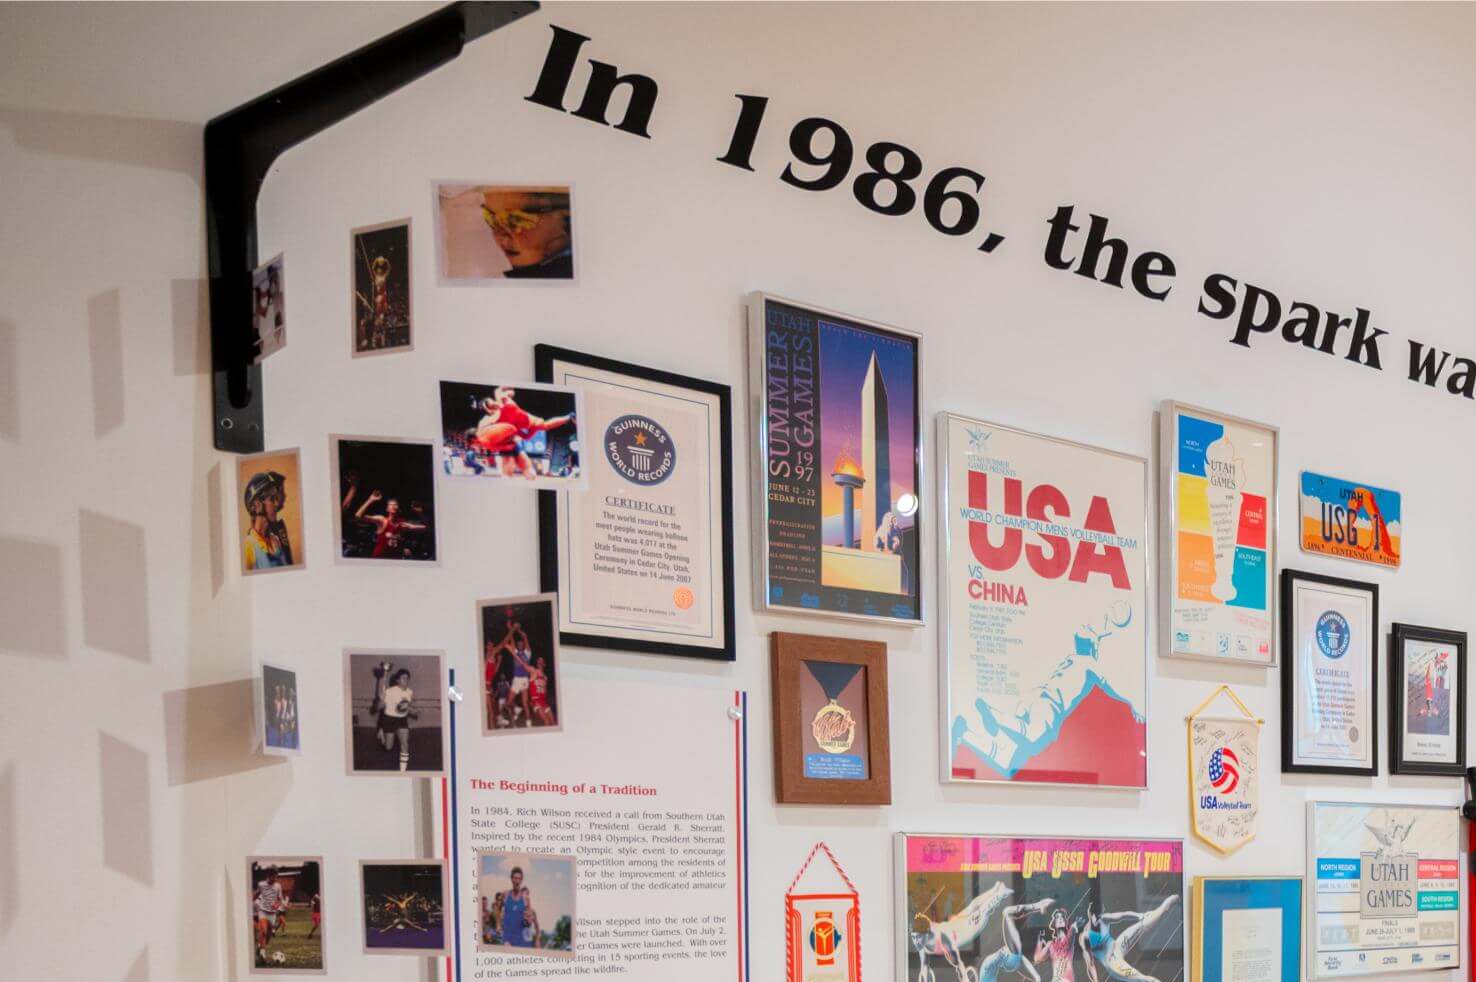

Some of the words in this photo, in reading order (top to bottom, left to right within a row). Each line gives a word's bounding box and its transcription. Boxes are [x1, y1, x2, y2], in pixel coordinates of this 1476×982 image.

[523, 23, 660, 140] In
[715, 93, 1006, 254] 1986,
[1043, 204, 1177, 302] the
[1197, 271, 1391, 371] spark
[793, 336, 814, 449] GAMES
[768, 331, 790, 478] SUMMER
[614, 419, 667, 444] GUINNESS
[608, 441, 636, 478] WORLD
[637, 451, 672, 481] RECORDS
[1210, 460, 1236, 475] UTAH
[794, 465, 814, 483] 97
[1210, 476, 1237, 489] GAMES
[768, 482, 790, 493] JUNE
[1339, 488, 1364, 500] UTAH
[768, 493, 796, 504] CEDAR
[797, 498, 817, 507] CITY
[603, 511, 615, 519] The
[638, 518, 659, 527] record
[660, 520, 669, 528] for
[960, 507, 993, 524] WORLD
[994, 514, 1043, 532] CHAMPION
[1045, 523, 1070, 537] MENS
[1070, 527, 1116, 546] VOLLEYBALL
[1115, 536, 1138, 549] TEAM
[1321, 502, 1358, 547] USG
[968, 470, 1131, 590] USA
[968, 579, 1028, 607] CHINA
[470, 779, 495, 790] The
[500, 779, 569, 796] Beginning
[572, 783, 587, 794] of
[589, 785, 597, 794] a
[600, 784, 657, 797] Tradition
[1200, 796, 1217, 809] USA
[470, 806, 480, 815] In
[516, 807, 537, 817] Rich
[540, 808, 571, 817] Wilson
[574, 809, 612, 819] received
[623, 810, 640, 819] call
[642, 810, 663, 820] from
[665, 812, 703, 821] Southern
[706, 812, 725, 821] Utah
[471, 819, 496, 828] State
[504, 820, 541, 830] College
[589, 822, 630, 831] President
[638, 823, 667, 832] Gerald
[471, 831, 510, 842] Inspired
[513, 832, 525, 842] by
[528, 832, 543, 841] the
[580, 833, 602, 842] 1984
[652, 834, 690, 843] President
[1022, 850, 1048, 879] USA
[1051, 850, 1085, 879] USSR
[1087, 850, 1142, 879] GOODWILL
[1143, 850, 1172, 879] TOUR
[1370, 863, 1409, 882] UTAH
[1366, 889, 1413, 908] GAMES
